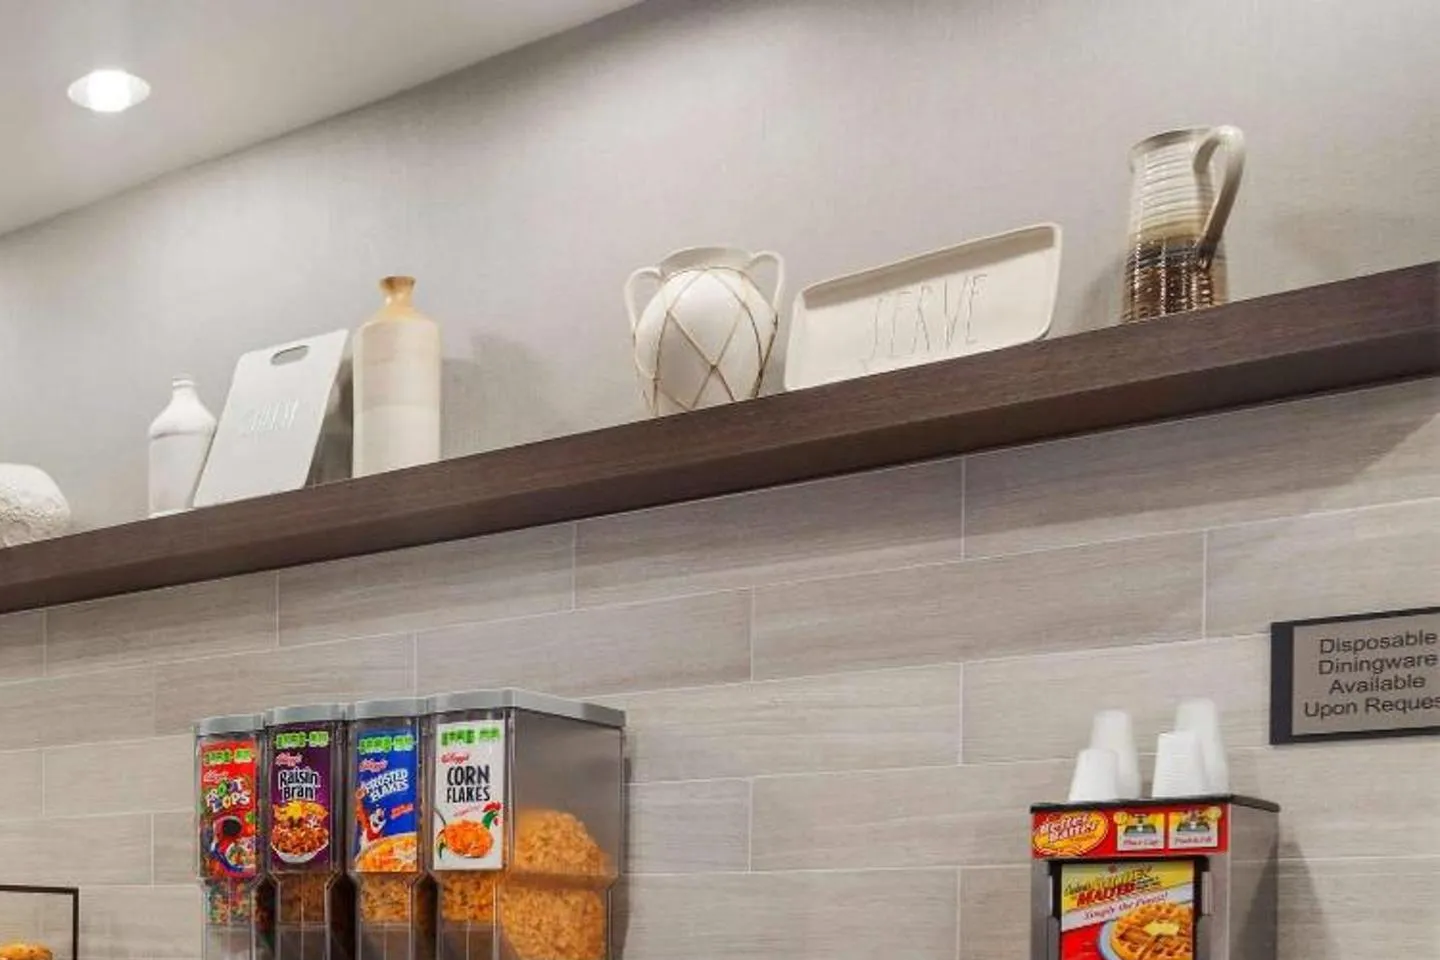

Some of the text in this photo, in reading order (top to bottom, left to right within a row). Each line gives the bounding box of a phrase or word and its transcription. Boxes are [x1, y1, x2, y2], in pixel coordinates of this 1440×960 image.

[1320, 629, 1438, 654] Disposable
[1318, 653, 1438, 675] Diningware
[1328, 674, 1427, 695] Available
[1304, 695, 1440, 720] Upon Reques
[278, 767, 319, 789] Raisin
[446, 764, 490, 787] CORN
[282, 786, 316, 803] Bran
[446, 785, 490, 804] FLAKES
